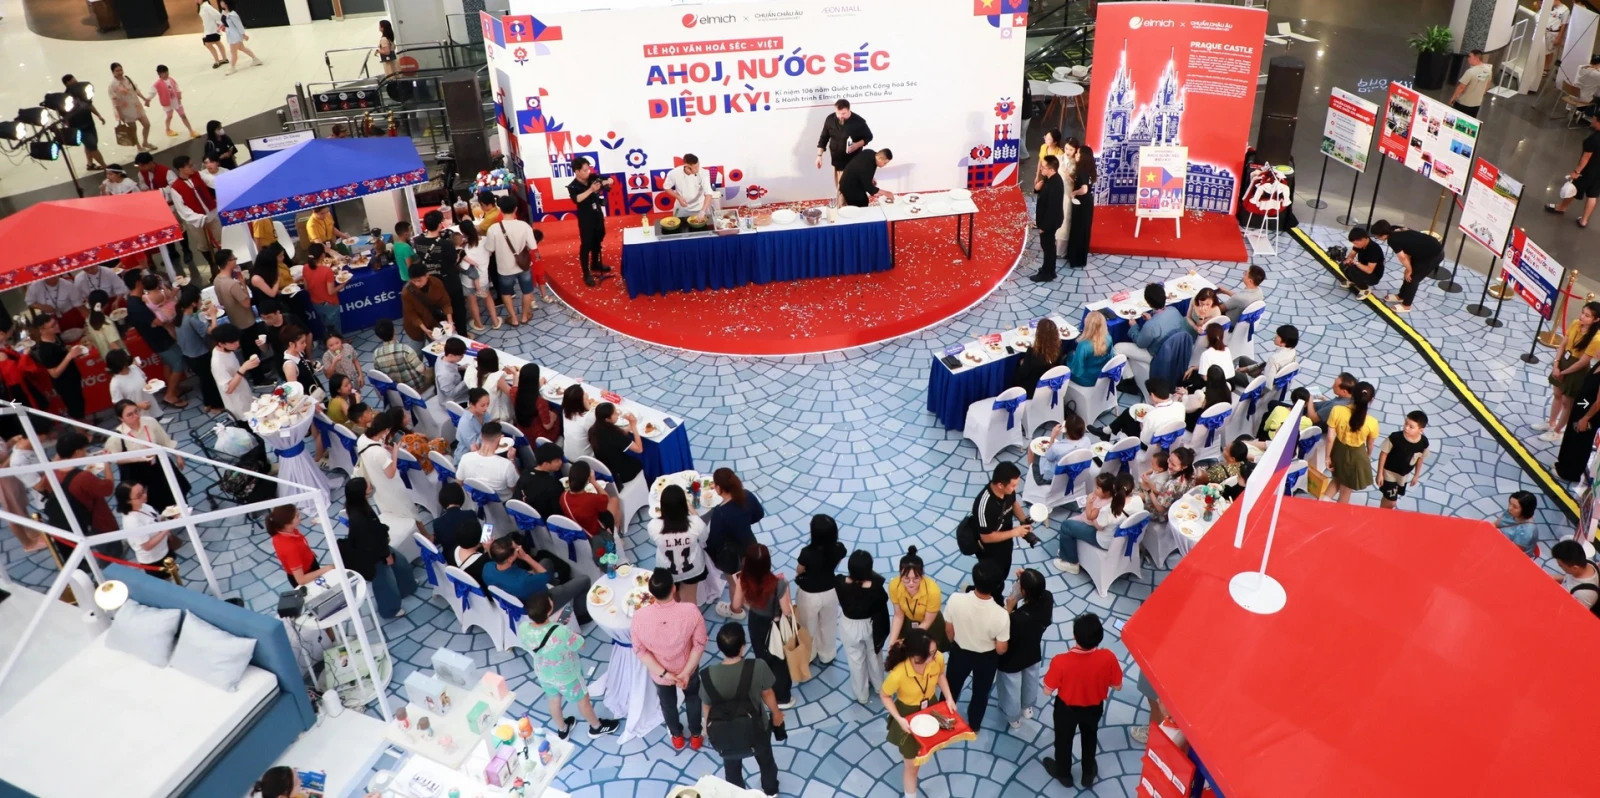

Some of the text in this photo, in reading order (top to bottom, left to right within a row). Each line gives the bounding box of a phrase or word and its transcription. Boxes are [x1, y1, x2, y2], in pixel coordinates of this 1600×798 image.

[842, 4, 862, 12] MALL
[700, 14, 736, 24] elmich
[1144, 19, 1174, 28] elmich
[647, 45, 658, 55] LỄ
[662, 45, 679, 56] HỘI
[682, 44, 702, 53] VĂN
[705, 42, 726, 51] HOÁ
[729, 42, 747, 50] SÉC
[757, 40, 778, 49] VIỆT
[1224, 43, 1254, 54] CASTLE
[646, 42, 890, 86] AHOJ, NƯỚC SÉC
[873, 82, 890, 90] Cộng
[648, 83, 770, 122] DIỆU KỲ!
[346, 281, 364, 290] elmich
[346, 296, 372, 312] HOÁ
[374, 291, 396, 304] SÉC
[666, 538, 690, 547] L.M.C
[665, 547, 694, 575] 11
